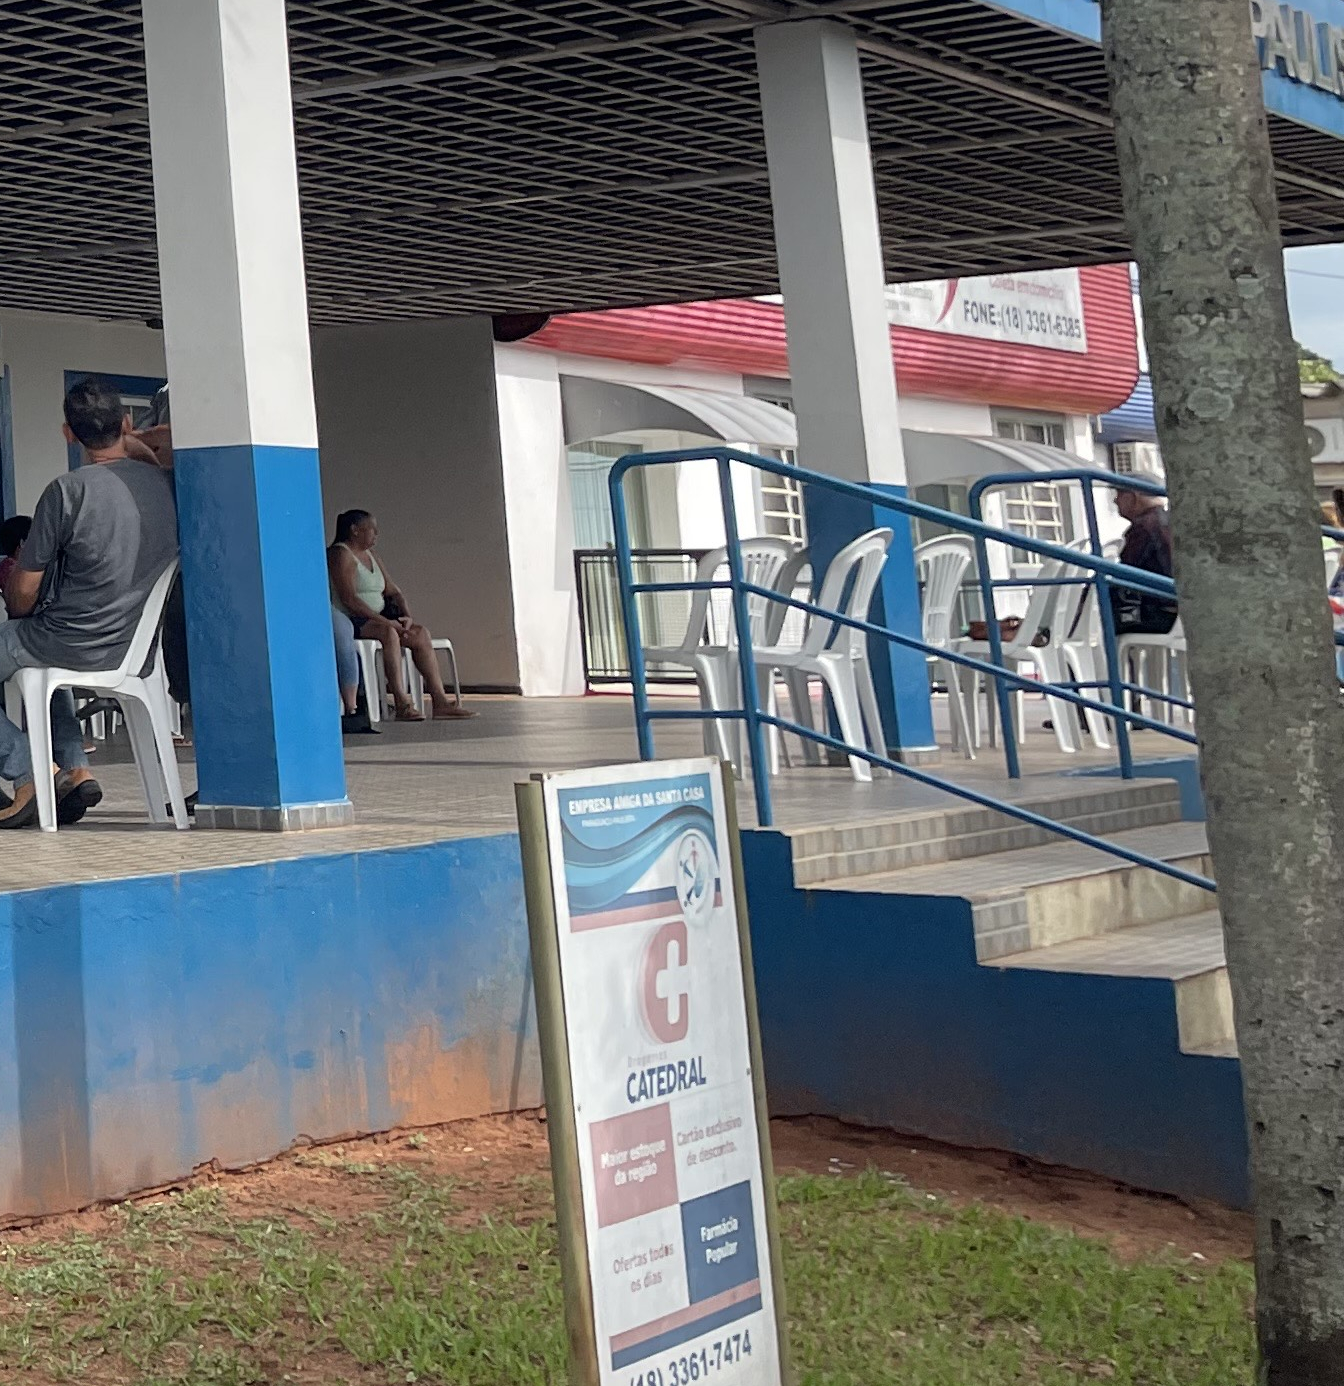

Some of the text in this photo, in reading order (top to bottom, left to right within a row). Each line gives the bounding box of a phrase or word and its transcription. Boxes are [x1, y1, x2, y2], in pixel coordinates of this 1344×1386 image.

[568, 786, 705, 815] EMPRESA AMIGA DA SANTA CASA
[627, 1055, 707, 1104] CATEDRAL
[669, 1329, 752, 1386] 3361-7474
